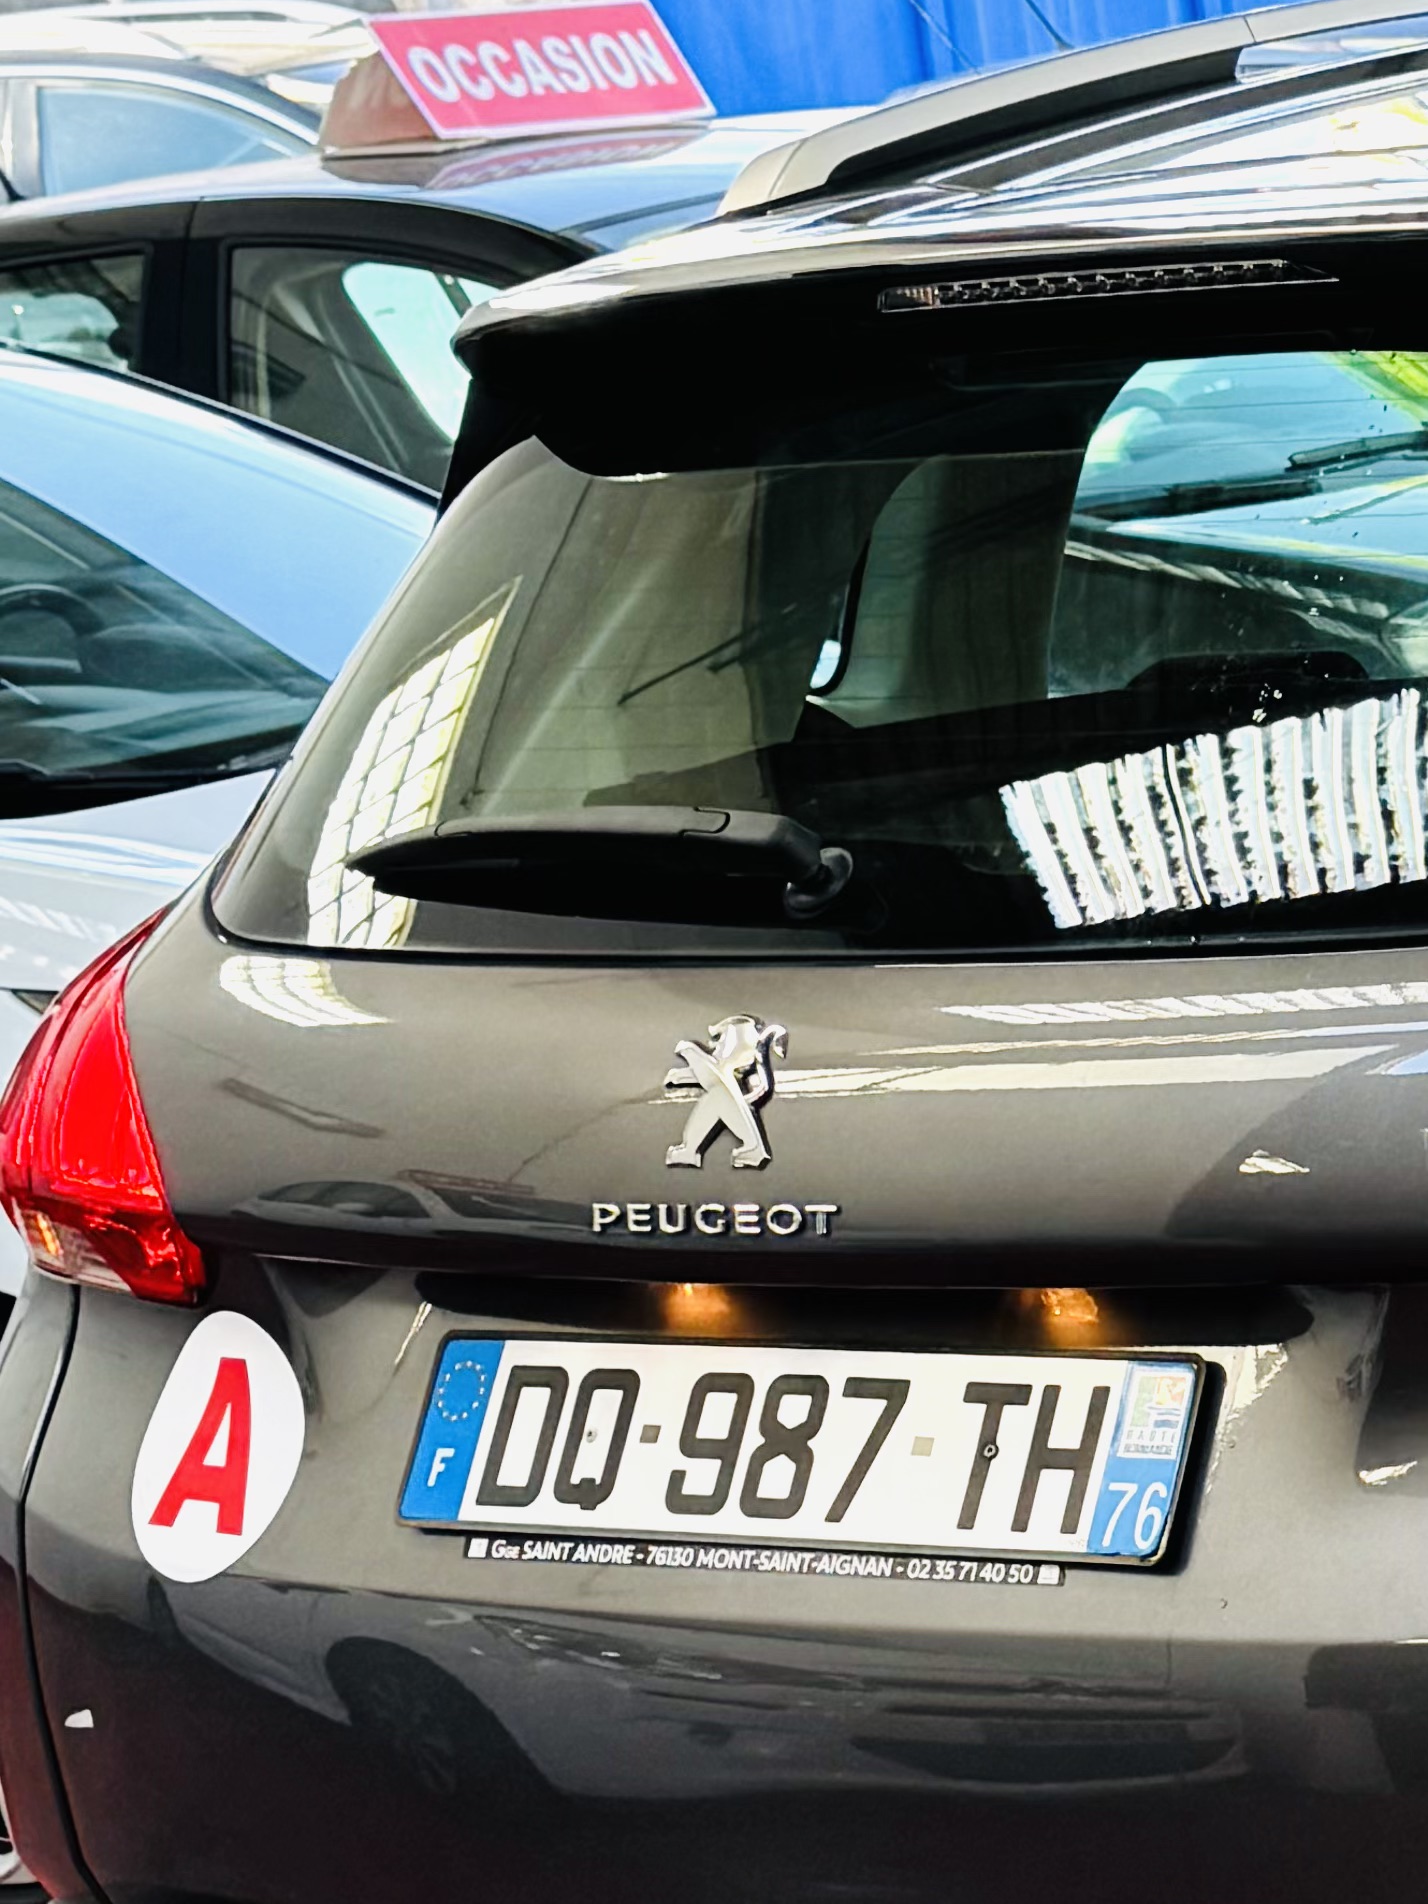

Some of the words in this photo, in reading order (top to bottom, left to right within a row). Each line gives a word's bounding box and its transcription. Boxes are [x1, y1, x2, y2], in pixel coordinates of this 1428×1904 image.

[407, 29, 676, 102] OCCASION
[591, 1202, 838, 1235] PEUGEOT
[148, 1357, 251, 1536] A
[427, 1447, 456, 1487] F
[1101, 1481, 1168, 1550] 76
[522, 1540, 574, 1562] SAINT
[573, 1543, 636, 1565] ANDRE
[646, 1546, 695, 1568] 76130
[696, 1549, 894, 1577] MONT-SAINT-AIGNAN
[907, 1559, 932, 1580] 02
[930, 1560, 956, 1581] 35
[958, 1562, 978, 1582] 71
[979, 1563, 1006, 1583] 40
[1008, 1564, 1034, 1585] 50
